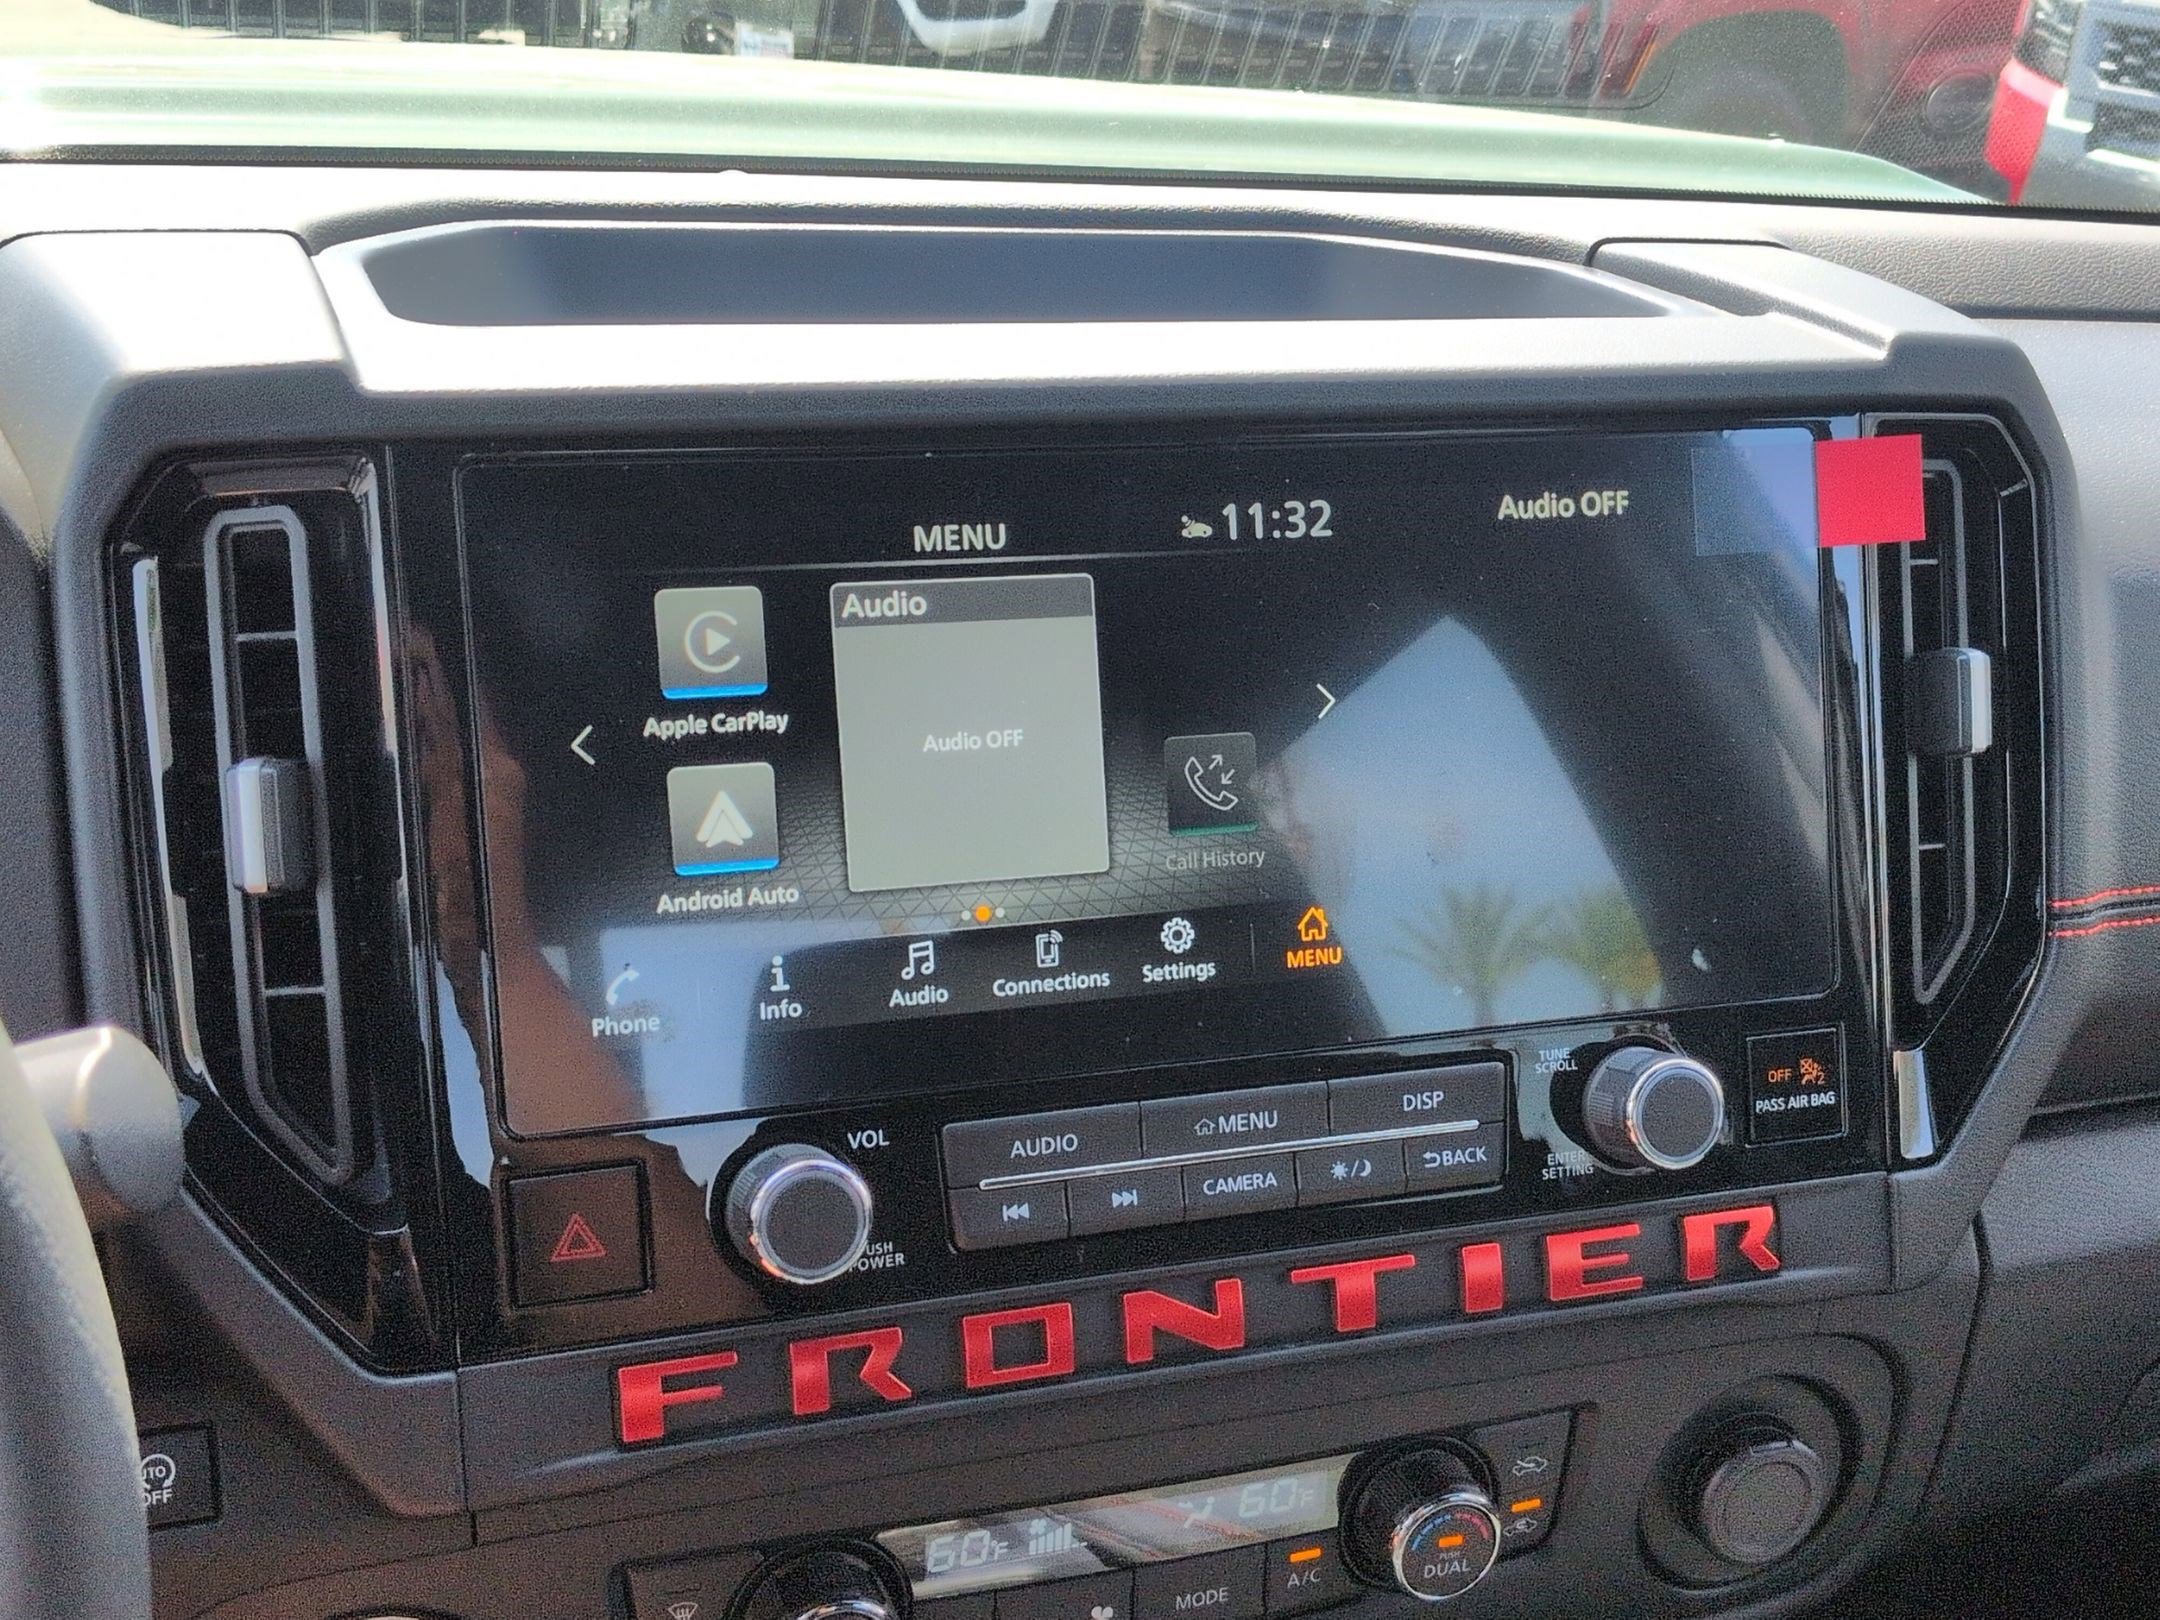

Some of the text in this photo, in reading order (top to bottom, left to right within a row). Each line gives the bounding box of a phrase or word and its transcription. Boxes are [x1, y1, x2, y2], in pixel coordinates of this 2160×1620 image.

[1497, 489, 1630, 520] Audio OFF
[1222, 499, 1333, 541] 11:32
[913, 523, 1007, 552] MENU
[841, 590, 928, 619] Audio
[643, 709, 789, 741] Apple CarPlay
[923, 728, 1024, 754] Audio OFF
[1165, 847, 1266, 872] Call History
[656, 885, 800, 915] Android Auto
[1286, 946, 1343, 969] MENU
[1142, 959, 1217, 984] Settings
[889, 984, 949, 1008] Audio
[992, 970, 1111, 998] Connections
[760, 1001, 803, 1021] Info
[591, 1014, 660, 1037] Phone
[1535, 1060, 1578, 1074] SCROLL
[1538, 1048, 1571, 1062] TUNE
[1768, 1067, 1792, 1083] OFF
[1403, 1090, 1445, 1112] DISP
[1755, 1090, 1837, 1114] PASS AIR BAG
[1217, 1109, 1279, 1135] MENU
[847, 1128, 890, 1150] VOL
[1010, 1133, 1078, 1159] AUDIO
[1442, 1146, 1488, 1168] BACK
[1547, 1150, 1587, 1167] ENTER
[1203, 1171, 1278, 1196] CAMERA
[1541, 1163, 1595, 1181] SETTING
[864, 1241, 893, 1256] USH
[616, 1204, 1782, 1443] FRONTIER
[1287, 1567, 1321, 1589] A/C
[1424, 1558, 1472, 1579] DUAL
[1175, 1586, 1230, 1611] MODE
